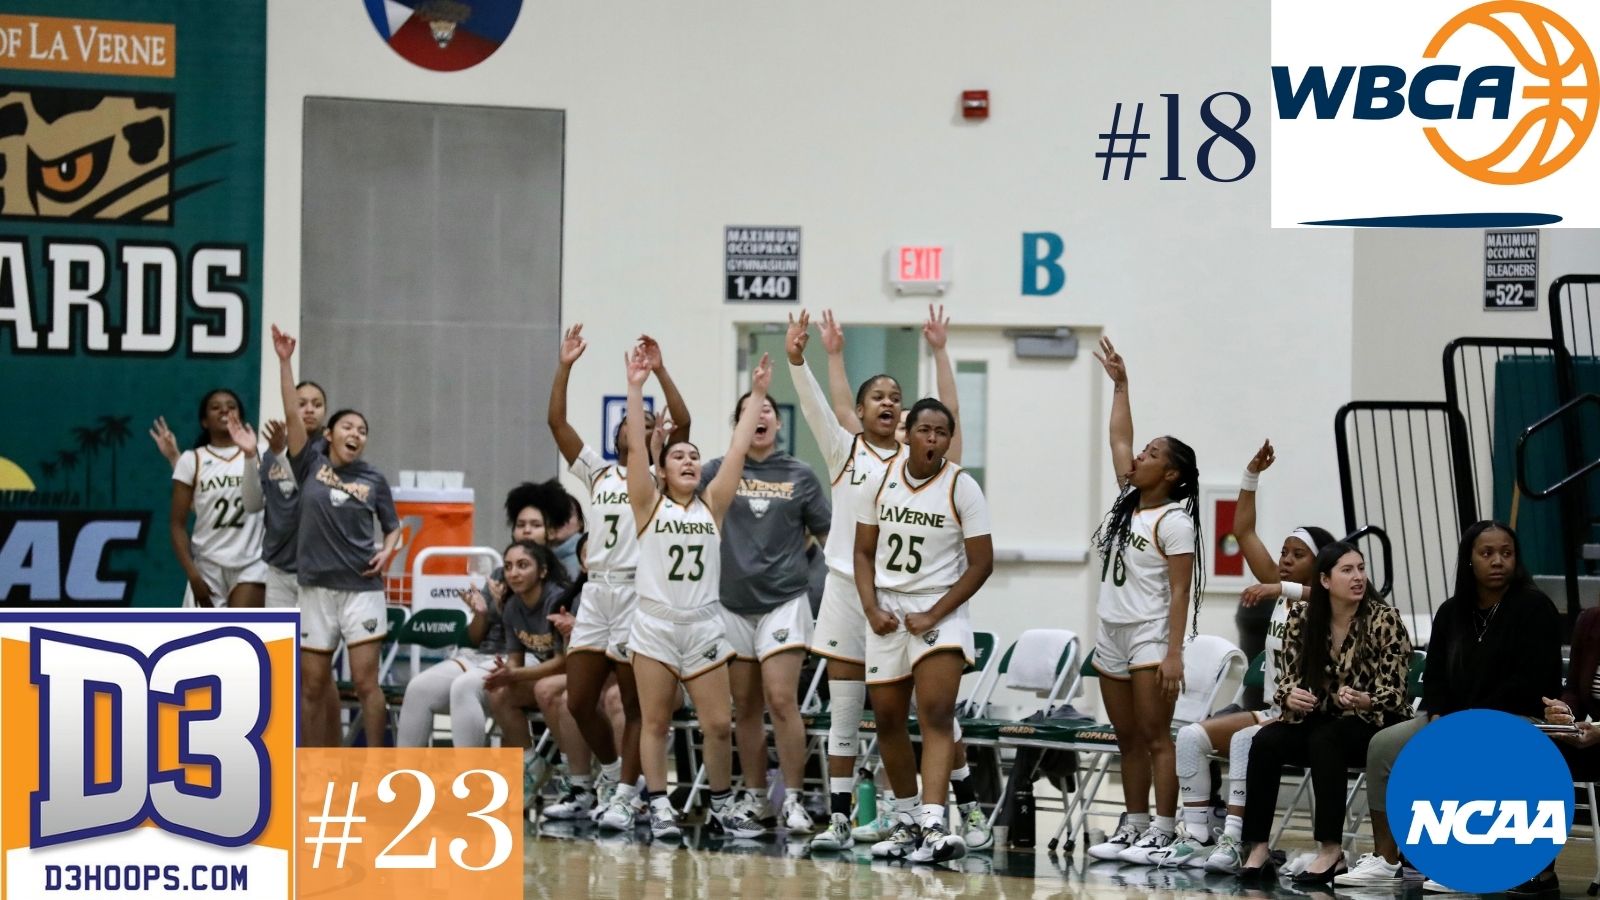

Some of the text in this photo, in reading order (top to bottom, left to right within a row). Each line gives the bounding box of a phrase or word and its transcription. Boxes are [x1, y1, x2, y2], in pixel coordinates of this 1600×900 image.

[29, 22, 69, 61] LA
[73, 25, 166, 67] VERNE
[727, 230, 797, 242] MAXIMUM
[727, 242, 797, 254] OCCUPANCY
[1487, 233, 1536, 247] MAXIMUM
[727, 259, 797, 271] GYMNASIUM
[900, 247, 943, 280] EXIT
[1021, 231, 1066, 296] B
[1487, 247, 1536, 259] OCCUPANCY
[1487, 264, 1536, 277] BLEACHERS
[734, 276, 791, 300] 1,440
[1495, 283, 1524, 306] 522
[212, 496, 246, 530] 22
[604, 514, 620, 549] 3
[668, 544, 705, 582] 23
[886, 533, 925, 574] 25
